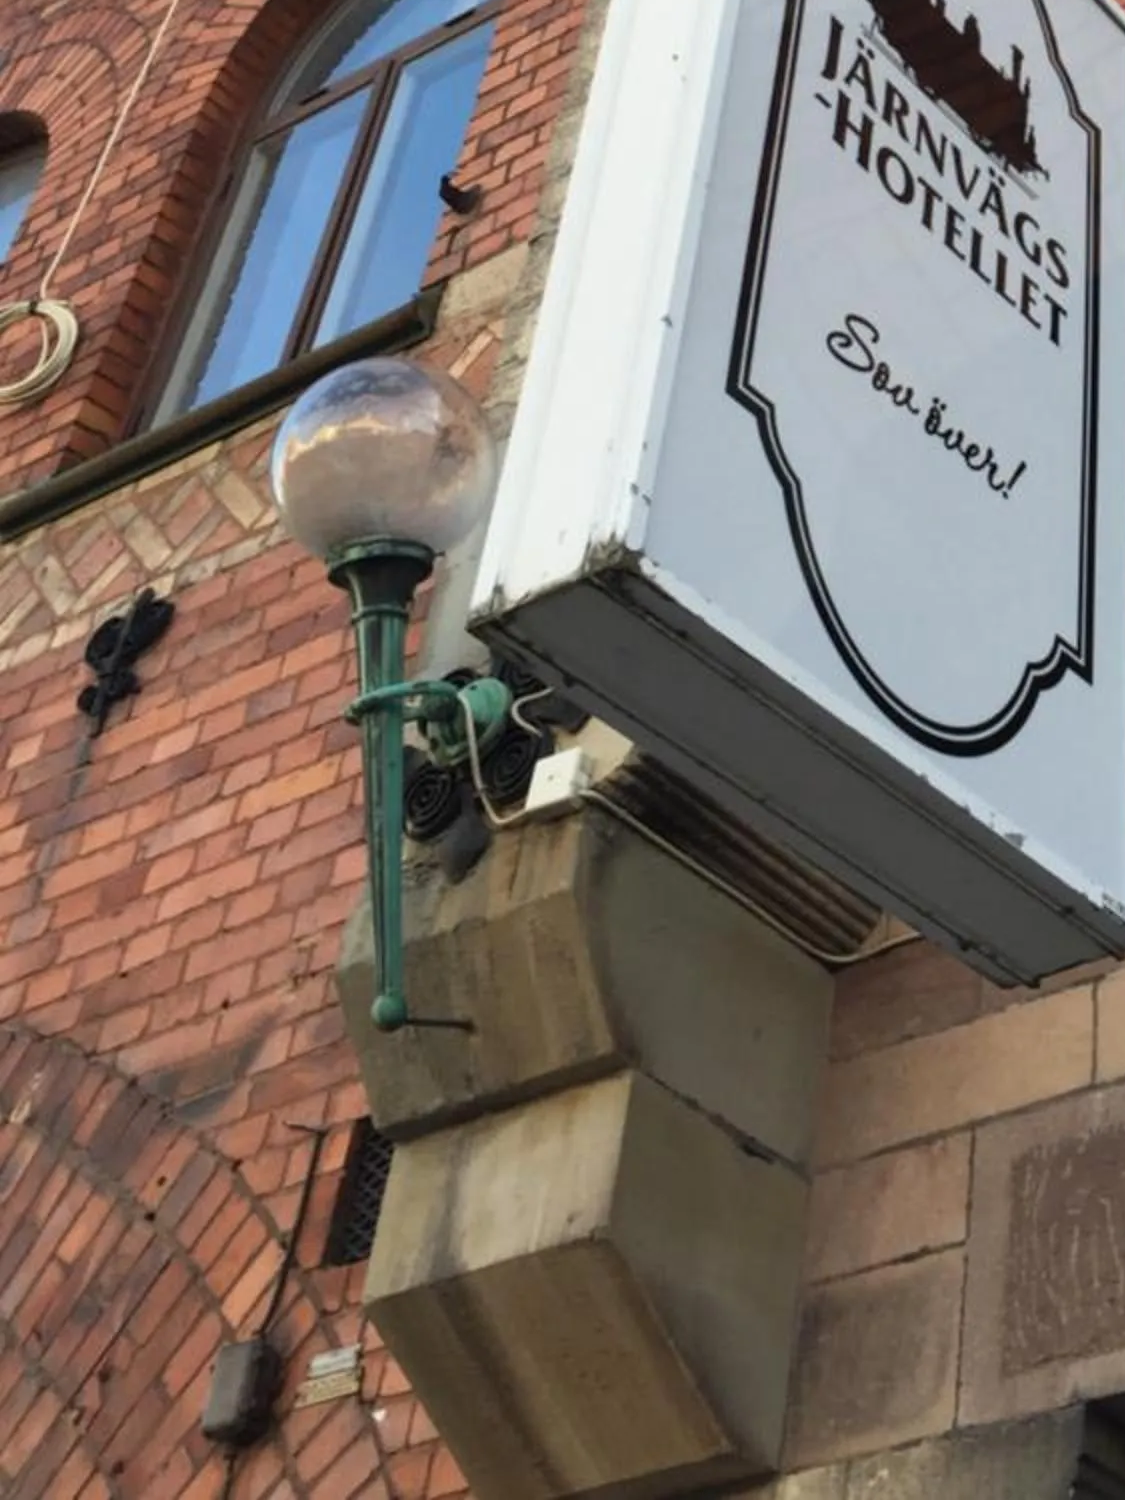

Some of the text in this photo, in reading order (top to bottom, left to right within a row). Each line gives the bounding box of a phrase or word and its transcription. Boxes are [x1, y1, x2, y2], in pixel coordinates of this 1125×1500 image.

[820, 14, 1070, 290] JÄRNVÄGS
[826, 313, 1027, 499] Sov över!
